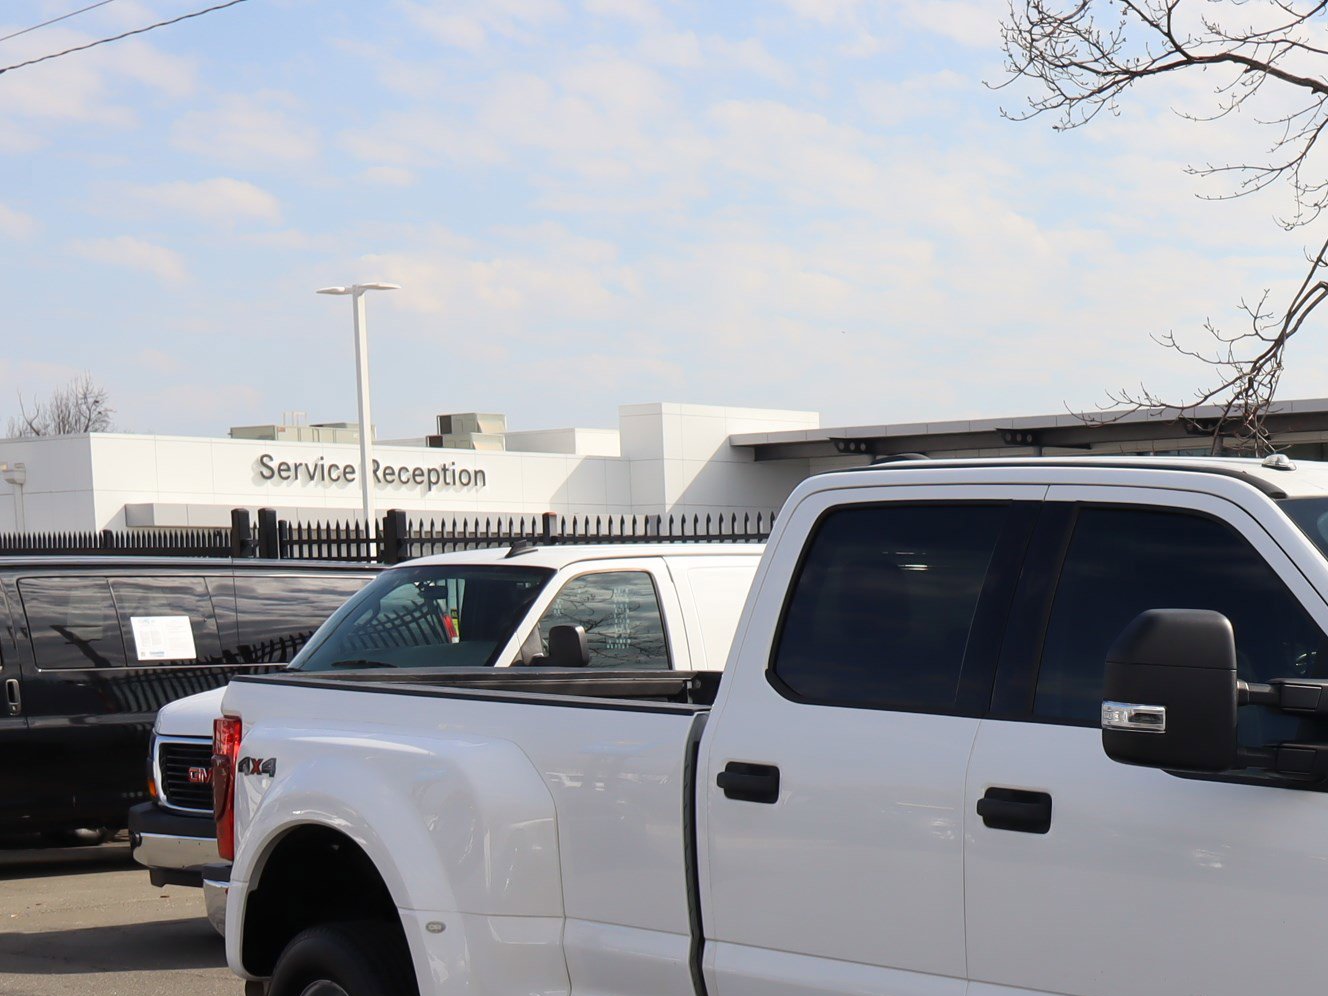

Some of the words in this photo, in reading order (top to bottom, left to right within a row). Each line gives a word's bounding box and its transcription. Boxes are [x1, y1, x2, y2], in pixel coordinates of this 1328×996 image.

[258, 453, 357, 483] Service
[372, 458, 487, 492] Reception
[188, 766, 214, 783] GM
